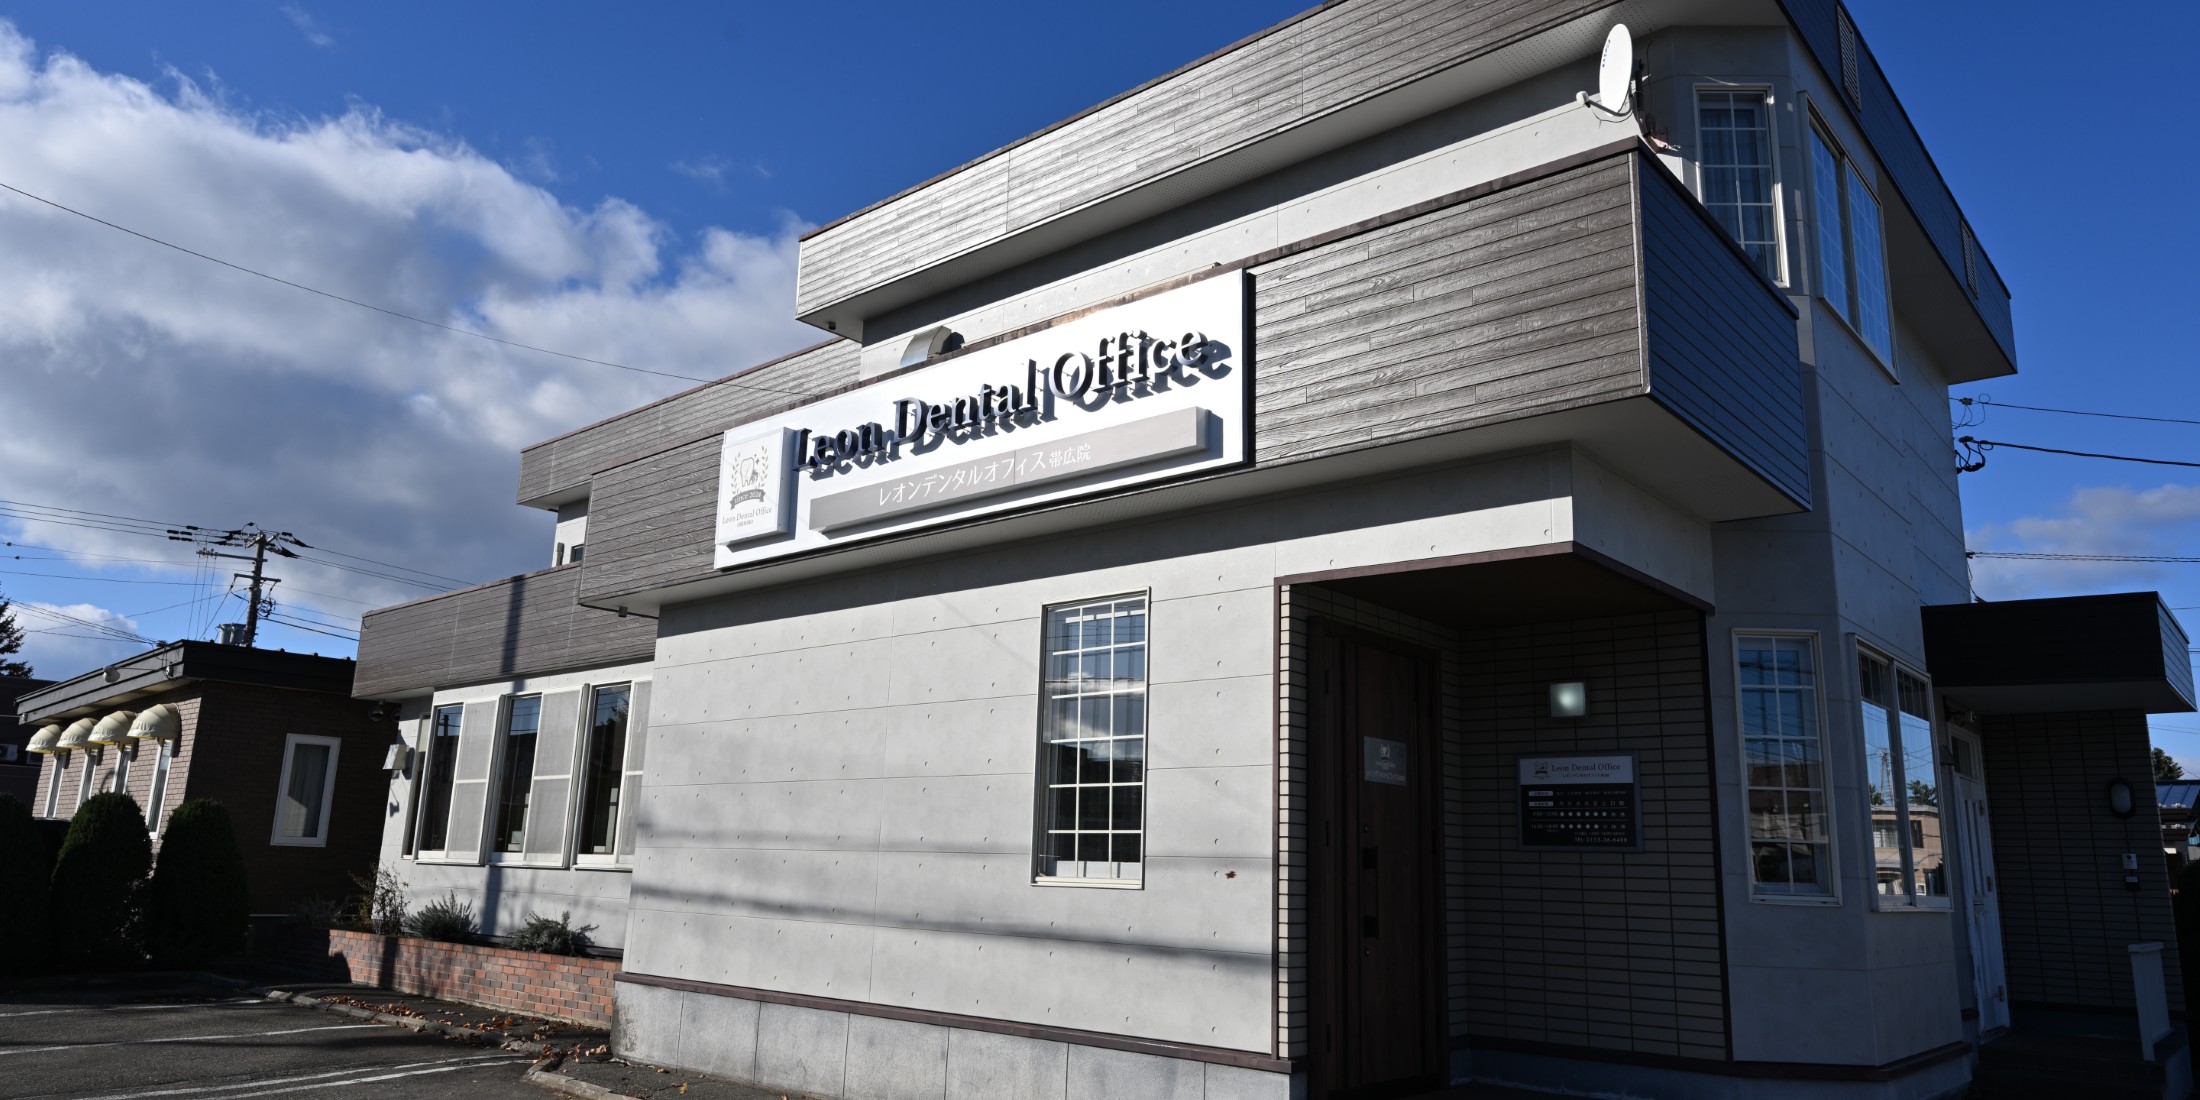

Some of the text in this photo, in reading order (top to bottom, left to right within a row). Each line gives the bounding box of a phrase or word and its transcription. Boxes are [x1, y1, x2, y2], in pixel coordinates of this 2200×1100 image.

[792, 329, 1209, 473] Leon Dental Office
[879, 443, 1092, 506] レオンデンタルオフィス 帯広院
[722, 507, 772, 524] Leon Dental Office
[1552, 763, 1621, 772] Leon Dental Office
